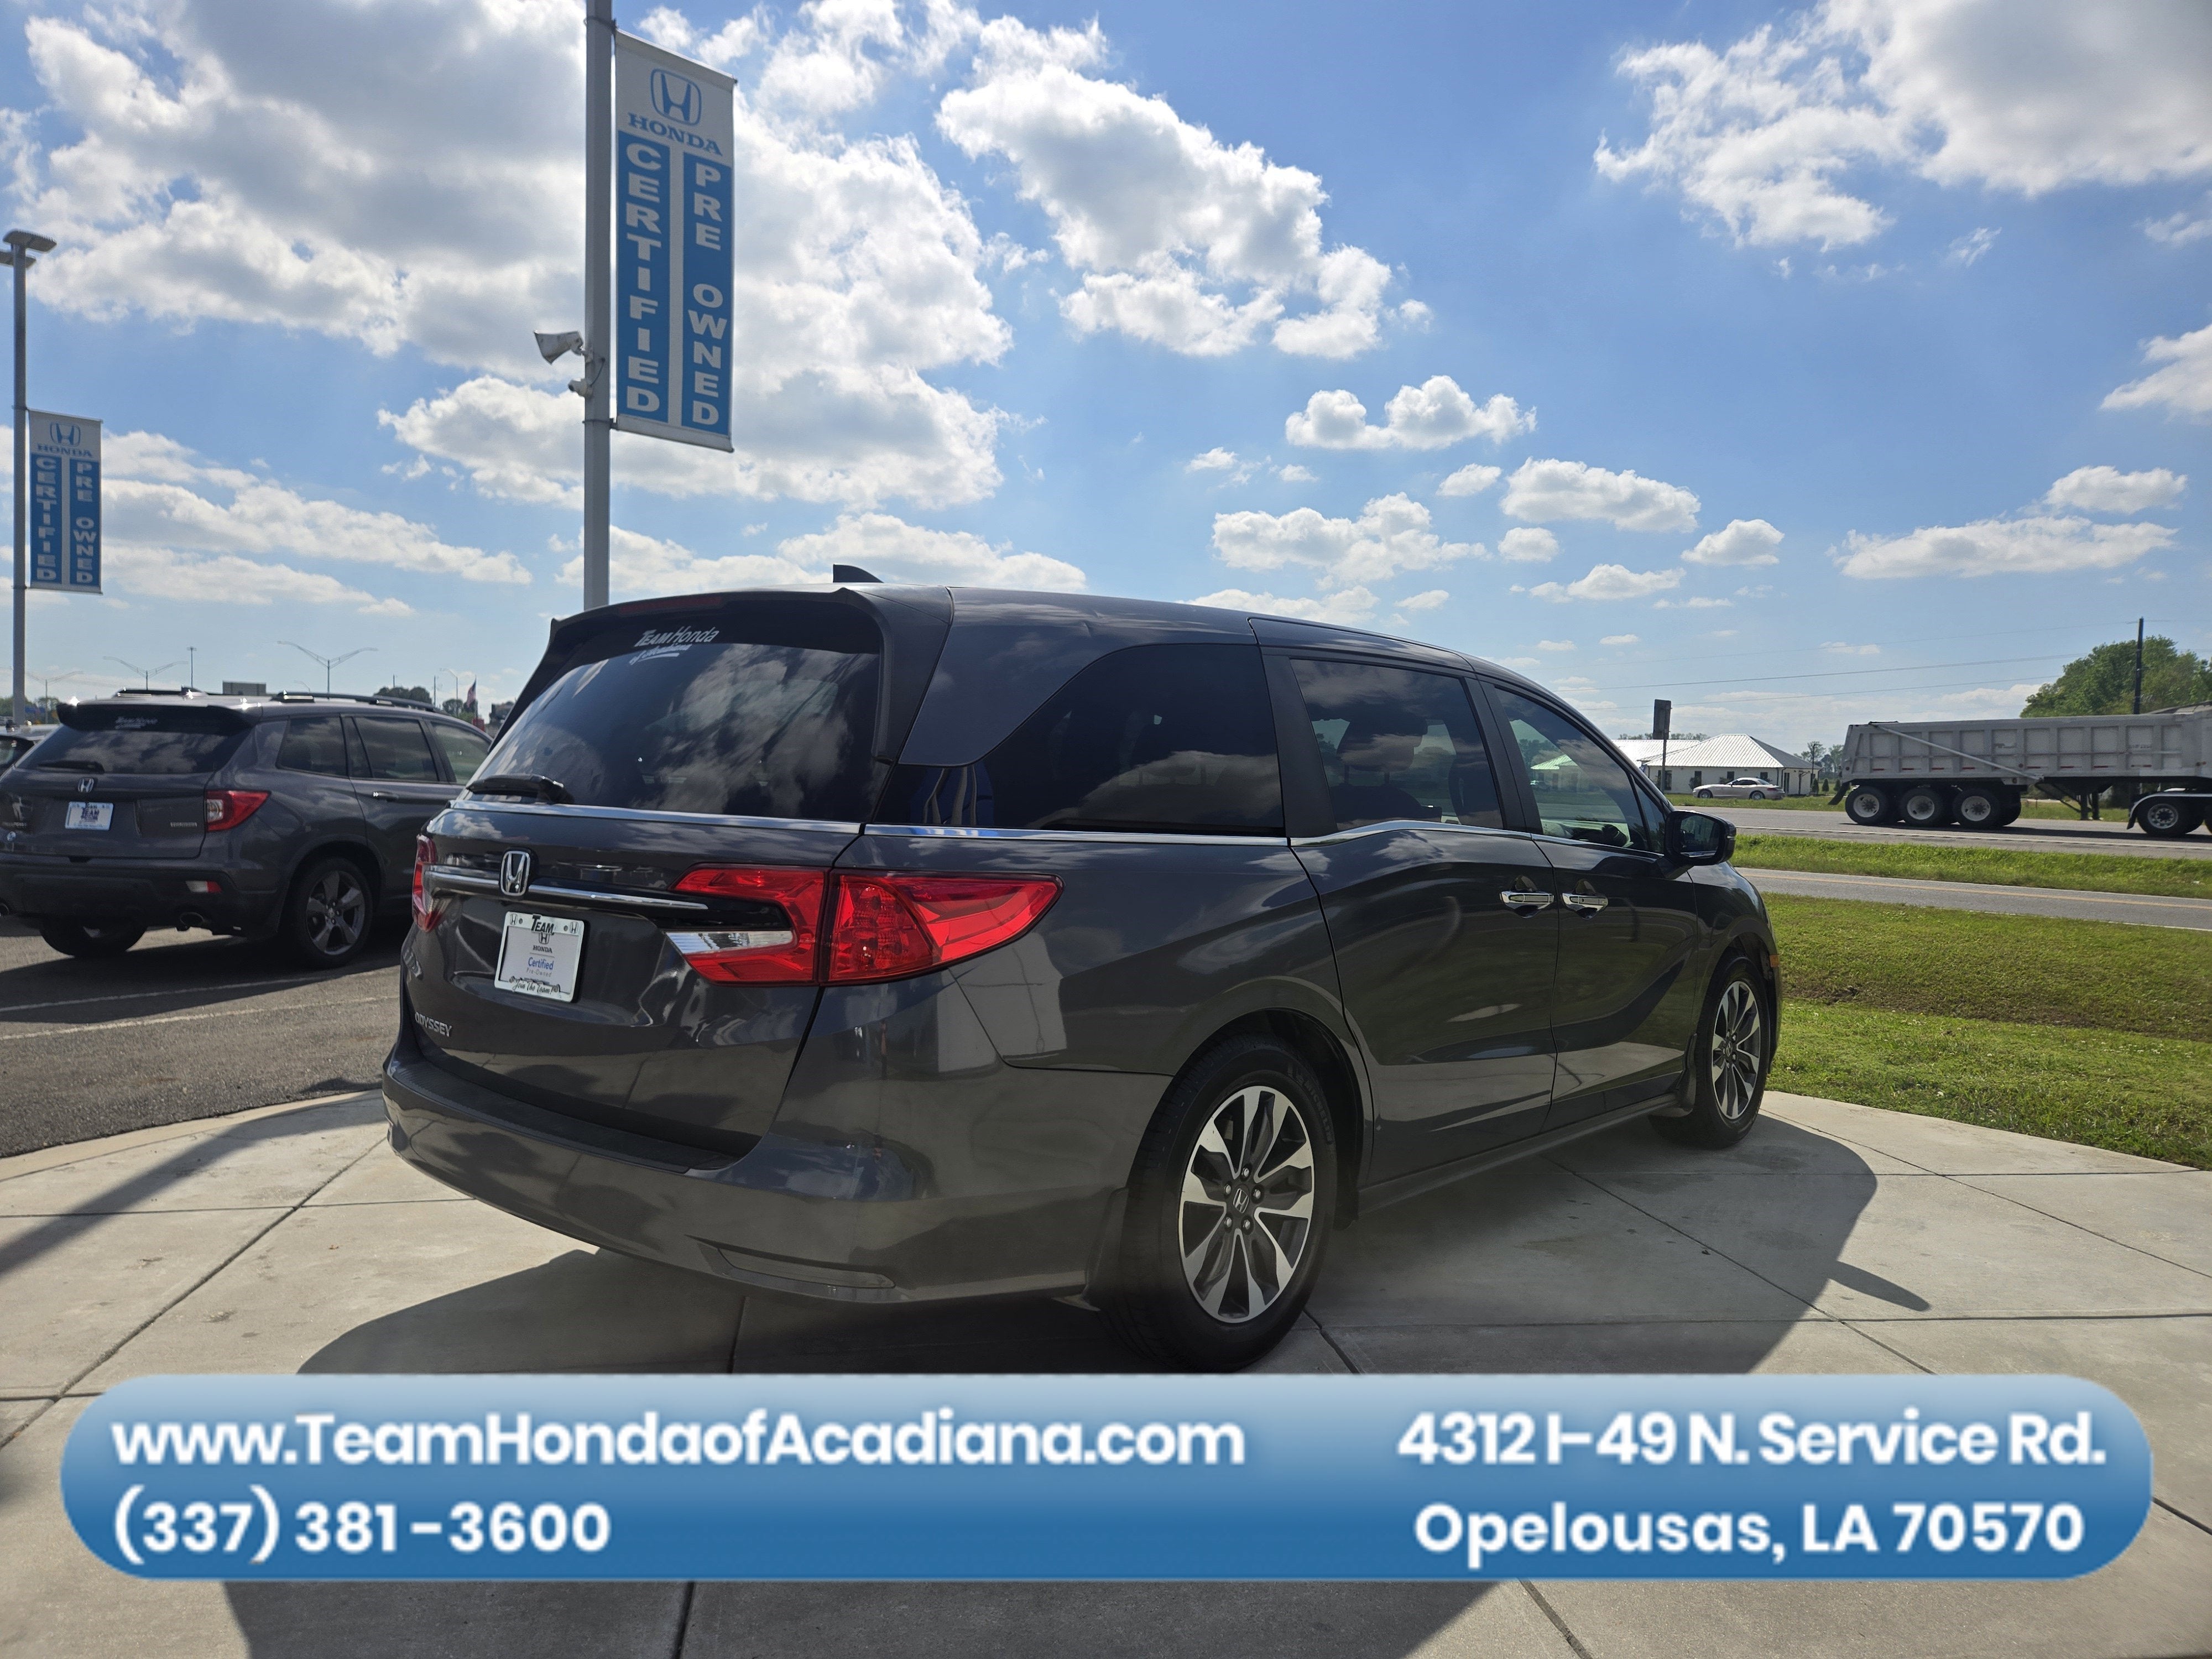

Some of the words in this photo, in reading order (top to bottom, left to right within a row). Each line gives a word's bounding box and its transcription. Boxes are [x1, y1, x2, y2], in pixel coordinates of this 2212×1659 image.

[628, 112, 723, 157] HONDA
[693, 166, 722, 252] PRE
[625, 142, 662, 413] CERTIFIED
[688, 283, 728, 426] OWNED
[37, 443, 93, 458] HONDA
[76, 461, 93, 503] PRE
[36, 457, 57, 581] CERTIFIED
[73, 517, 97, 584] OWNED
[531, 914, 554, 934] TEAM
[528, 957, 554, 971] Certified
[533, 945, 553, 953] HONDA
[512, 979, 525, 990] Join
[526, 982, 535, 992] The
[526, 967, 552, 977] Pre-Owned
[415, 1011, 452, 1037] ODYSSEY
